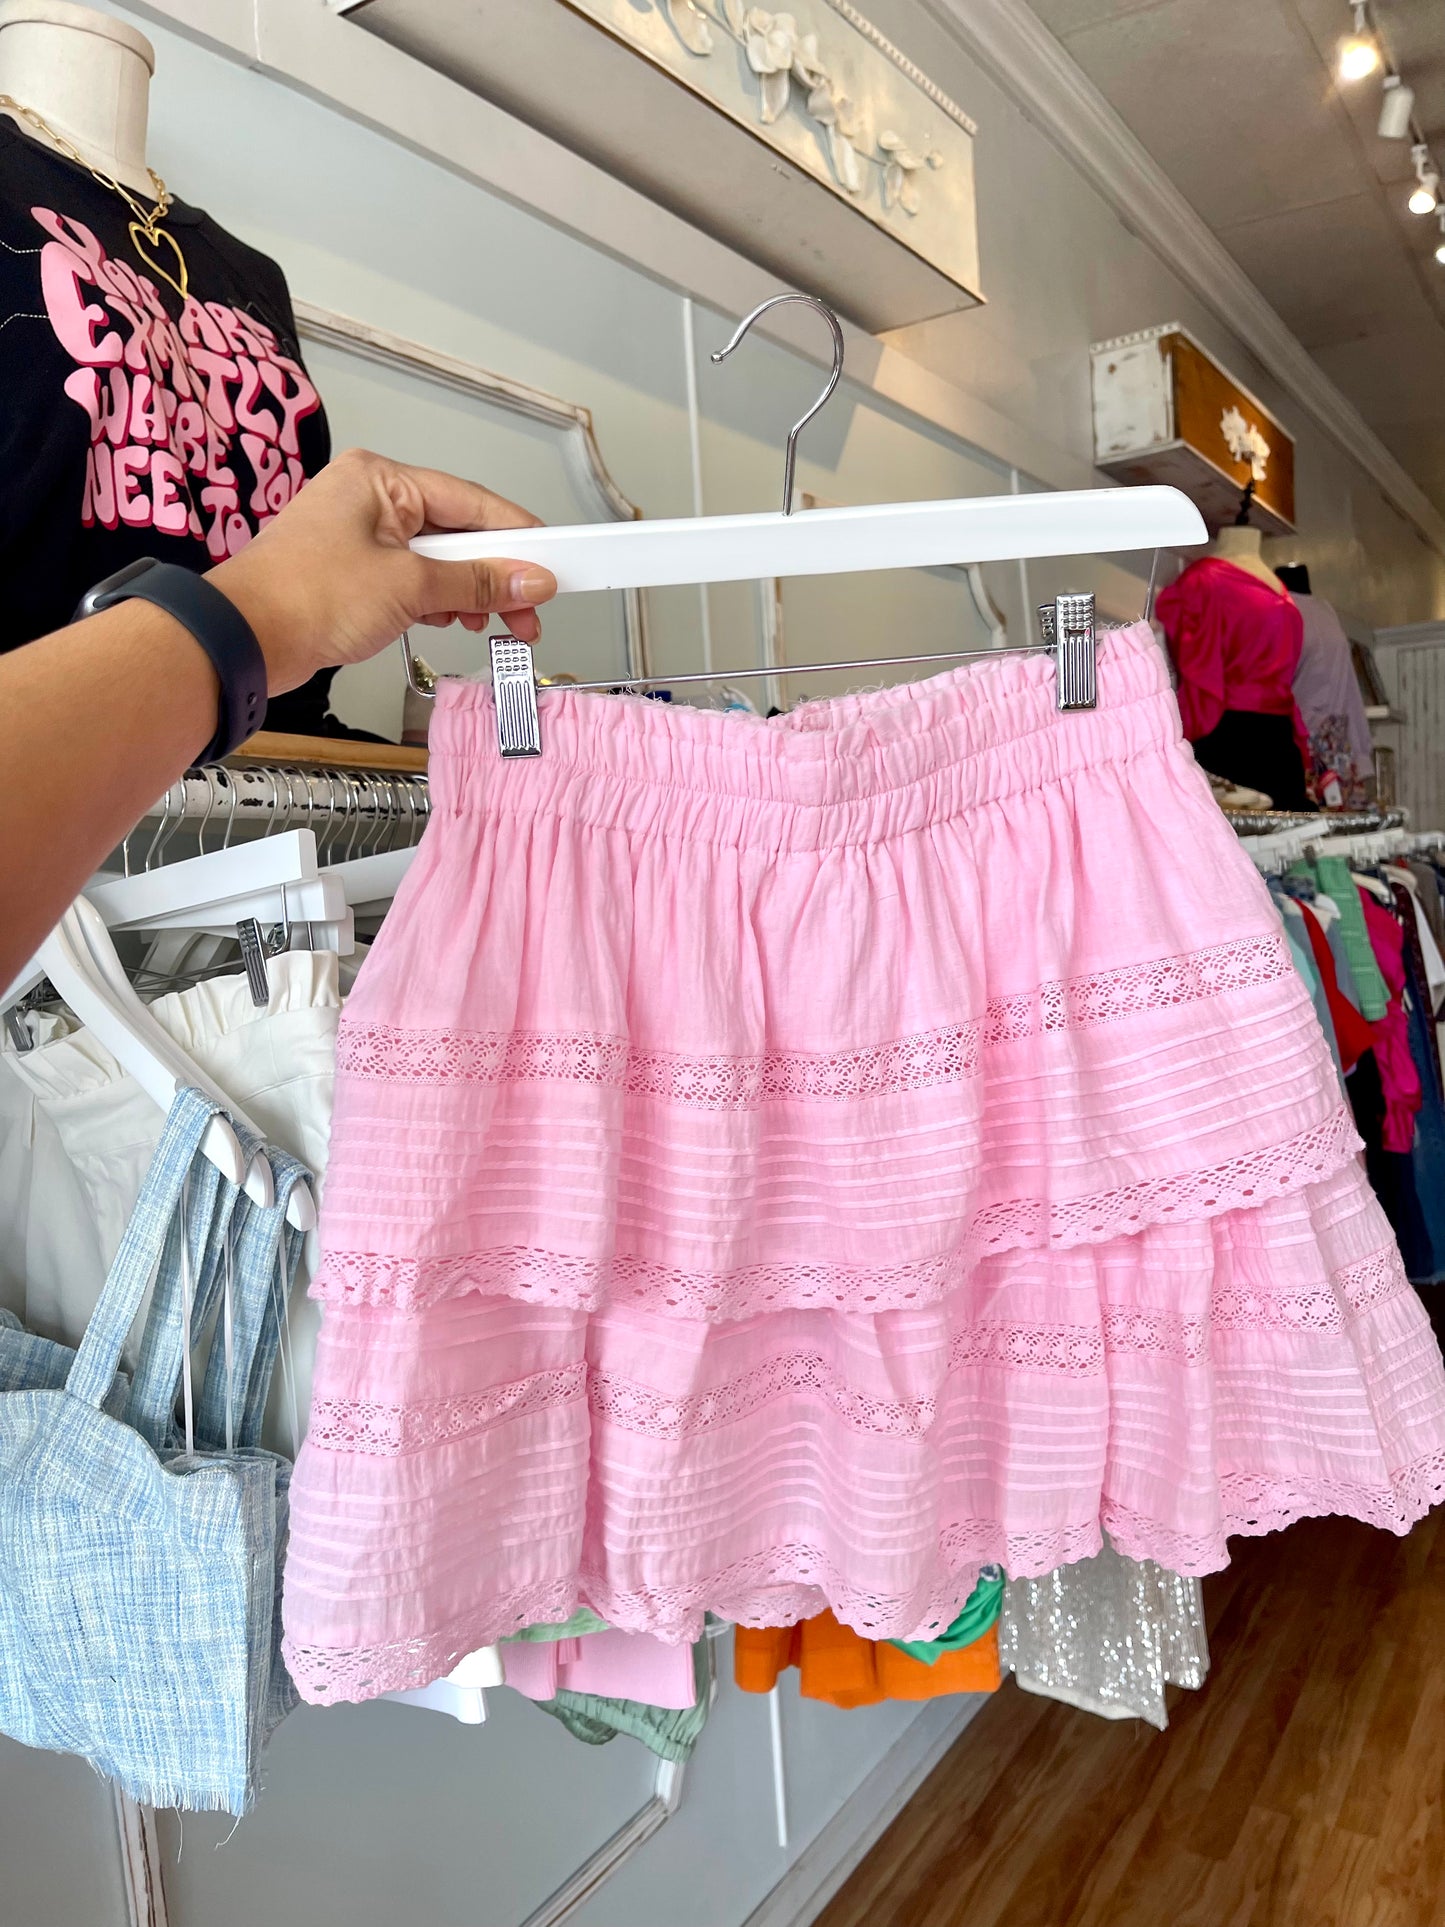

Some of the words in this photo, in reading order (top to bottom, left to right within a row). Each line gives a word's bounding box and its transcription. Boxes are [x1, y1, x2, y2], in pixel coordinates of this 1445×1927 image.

[31, 206, 170, 325] YOU
[179, 292, 280, 359] ARE
[40, 240, 320, 458] EXATLY
[81, 441, 205, 541] NEE
[201, 486, 253, 563] TO
